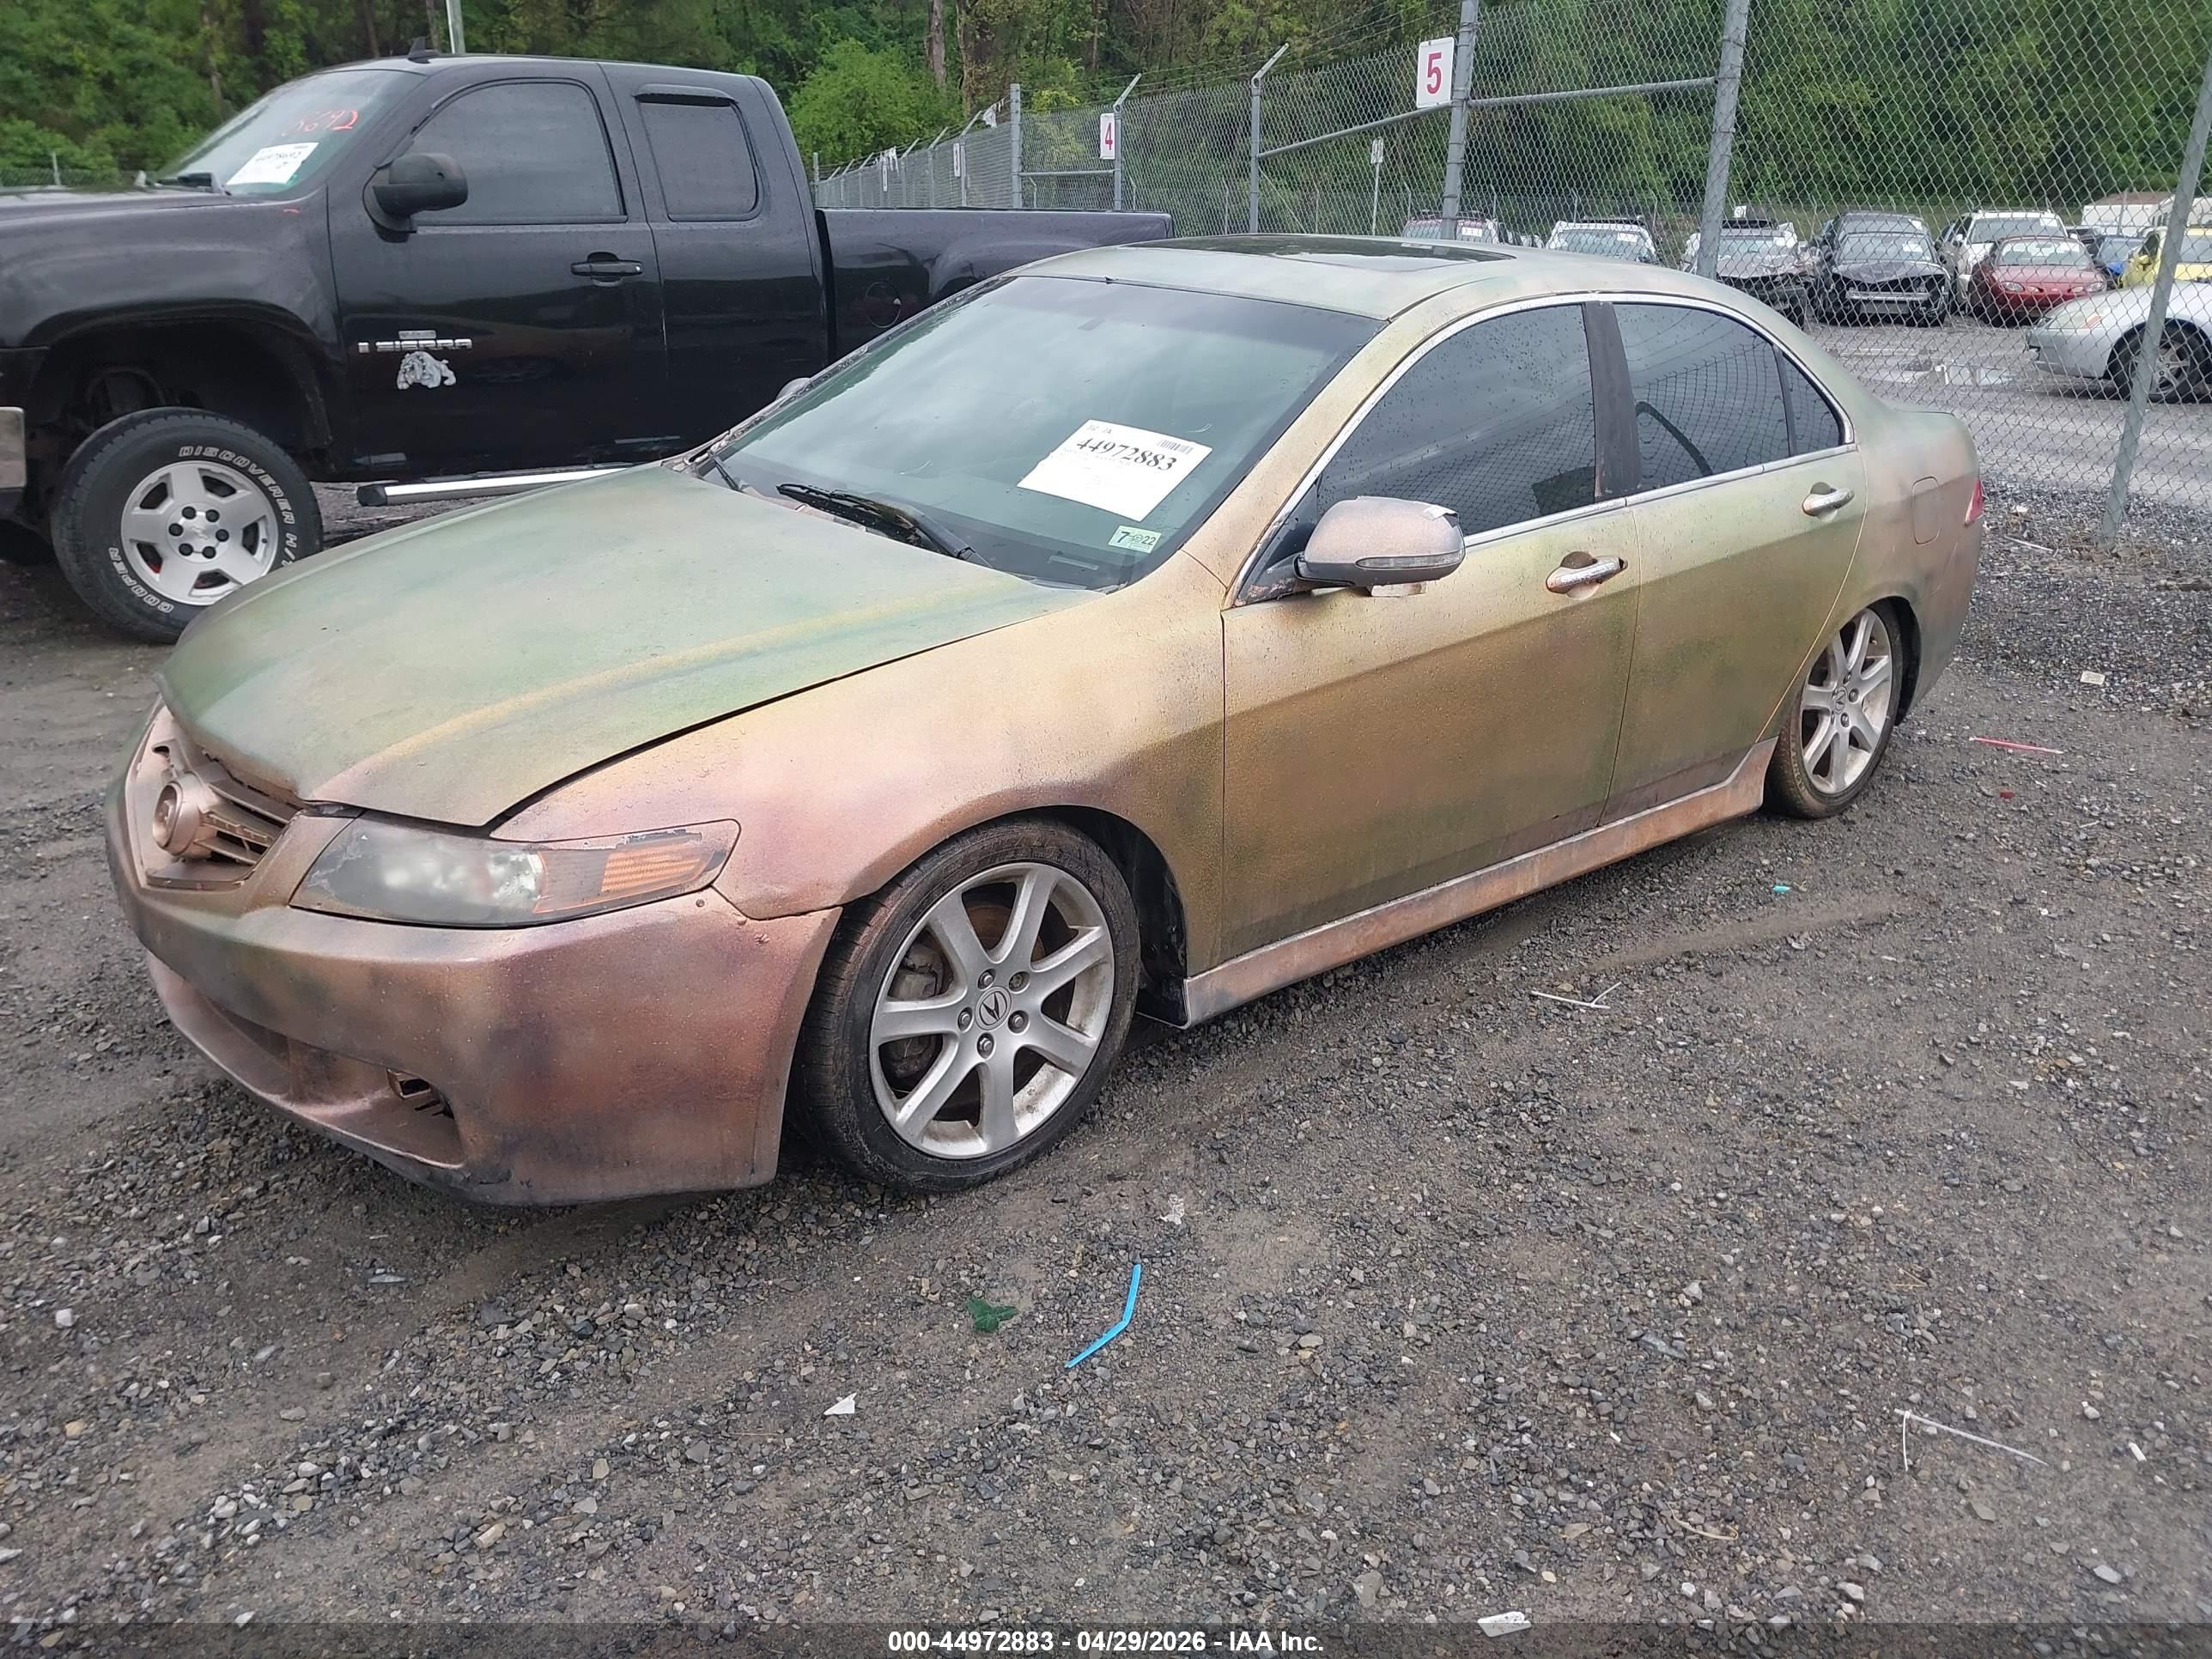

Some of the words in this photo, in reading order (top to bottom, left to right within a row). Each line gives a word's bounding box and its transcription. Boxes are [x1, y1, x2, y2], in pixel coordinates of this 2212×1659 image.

[1426, 52, 1443, 94] 5
[1104, 122, 1114, 151] 4
[1077, 438, 1177, 471] 44972883
[179, 446, 295, 525] DISCOVERER
[1116, 531, 1131, 544] 7
[108, 547, 174, 613] COOPER
